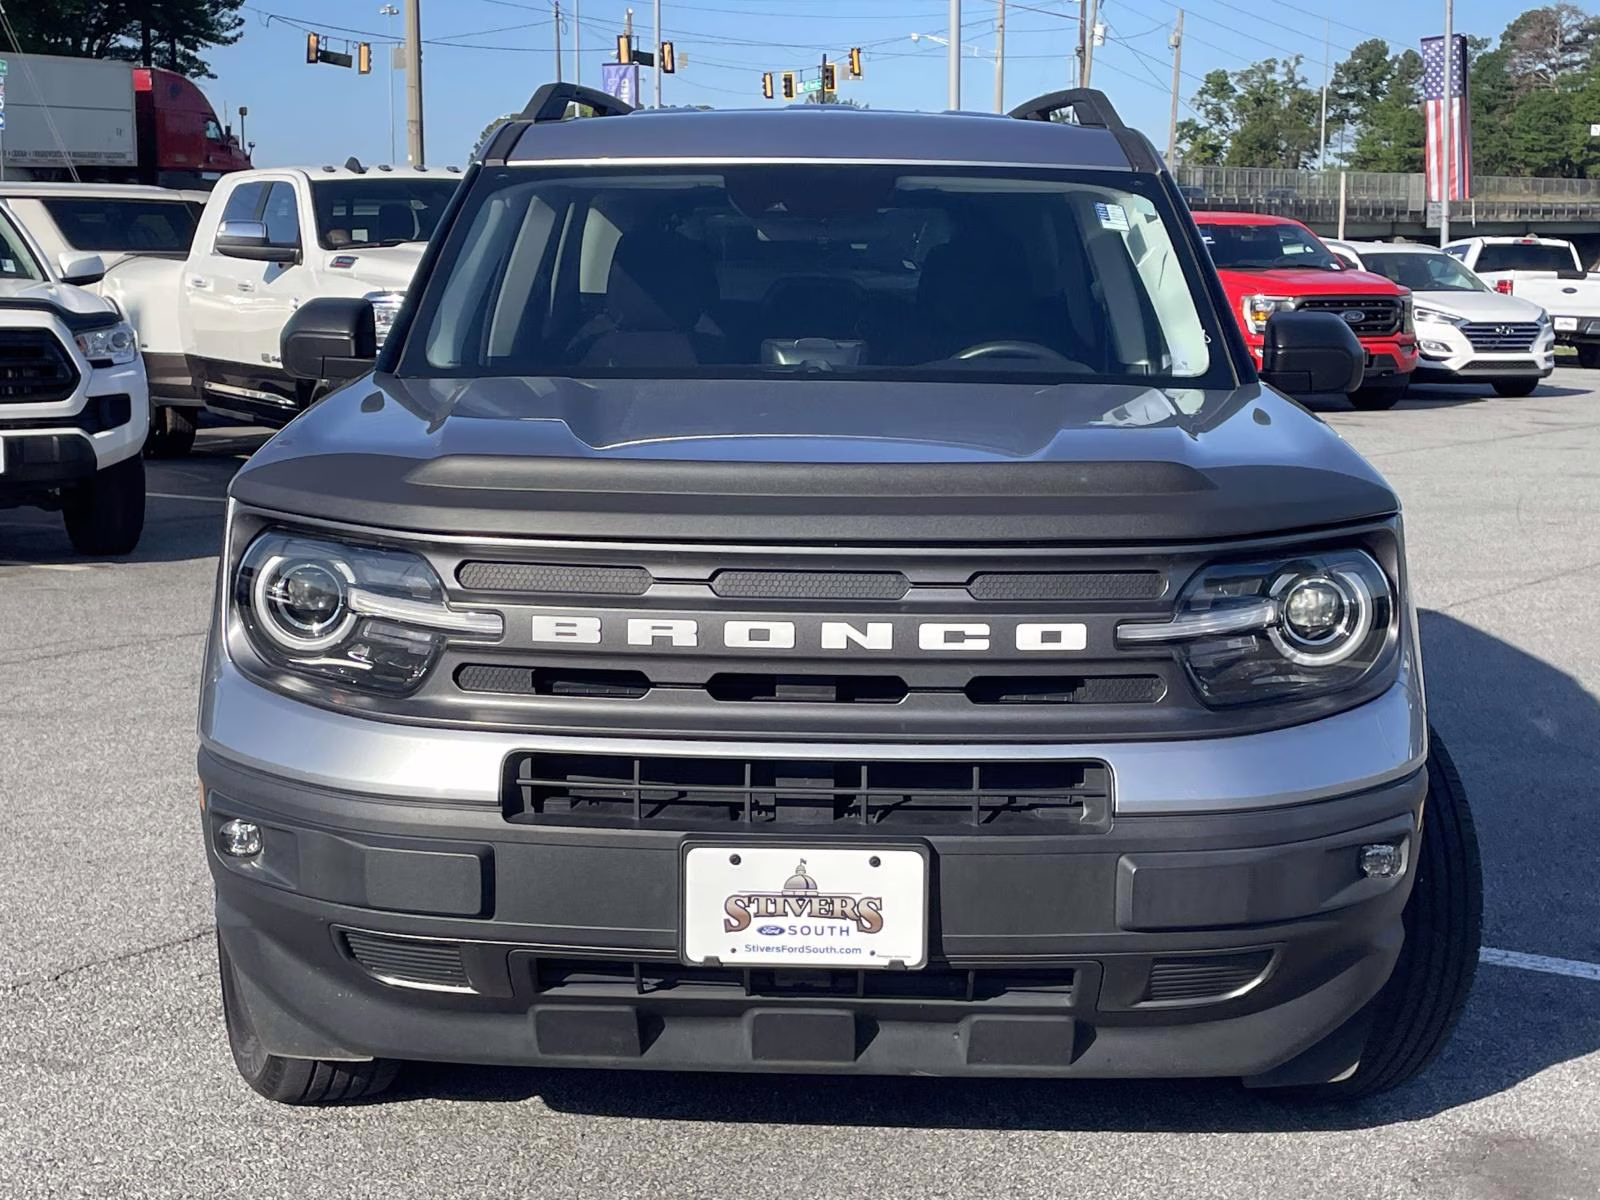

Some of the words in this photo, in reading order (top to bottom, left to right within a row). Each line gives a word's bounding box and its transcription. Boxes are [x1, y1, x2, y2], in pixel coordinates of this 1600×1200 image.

[531, 615, 1087, 651] BRONCO
[724, 894, 884, 934] STIVERS
[761, 925, 782, 935] Ford
[788, 925, 850, 936] SOUTH
[744, 943, 862, 955] StiversFordSouth.com
